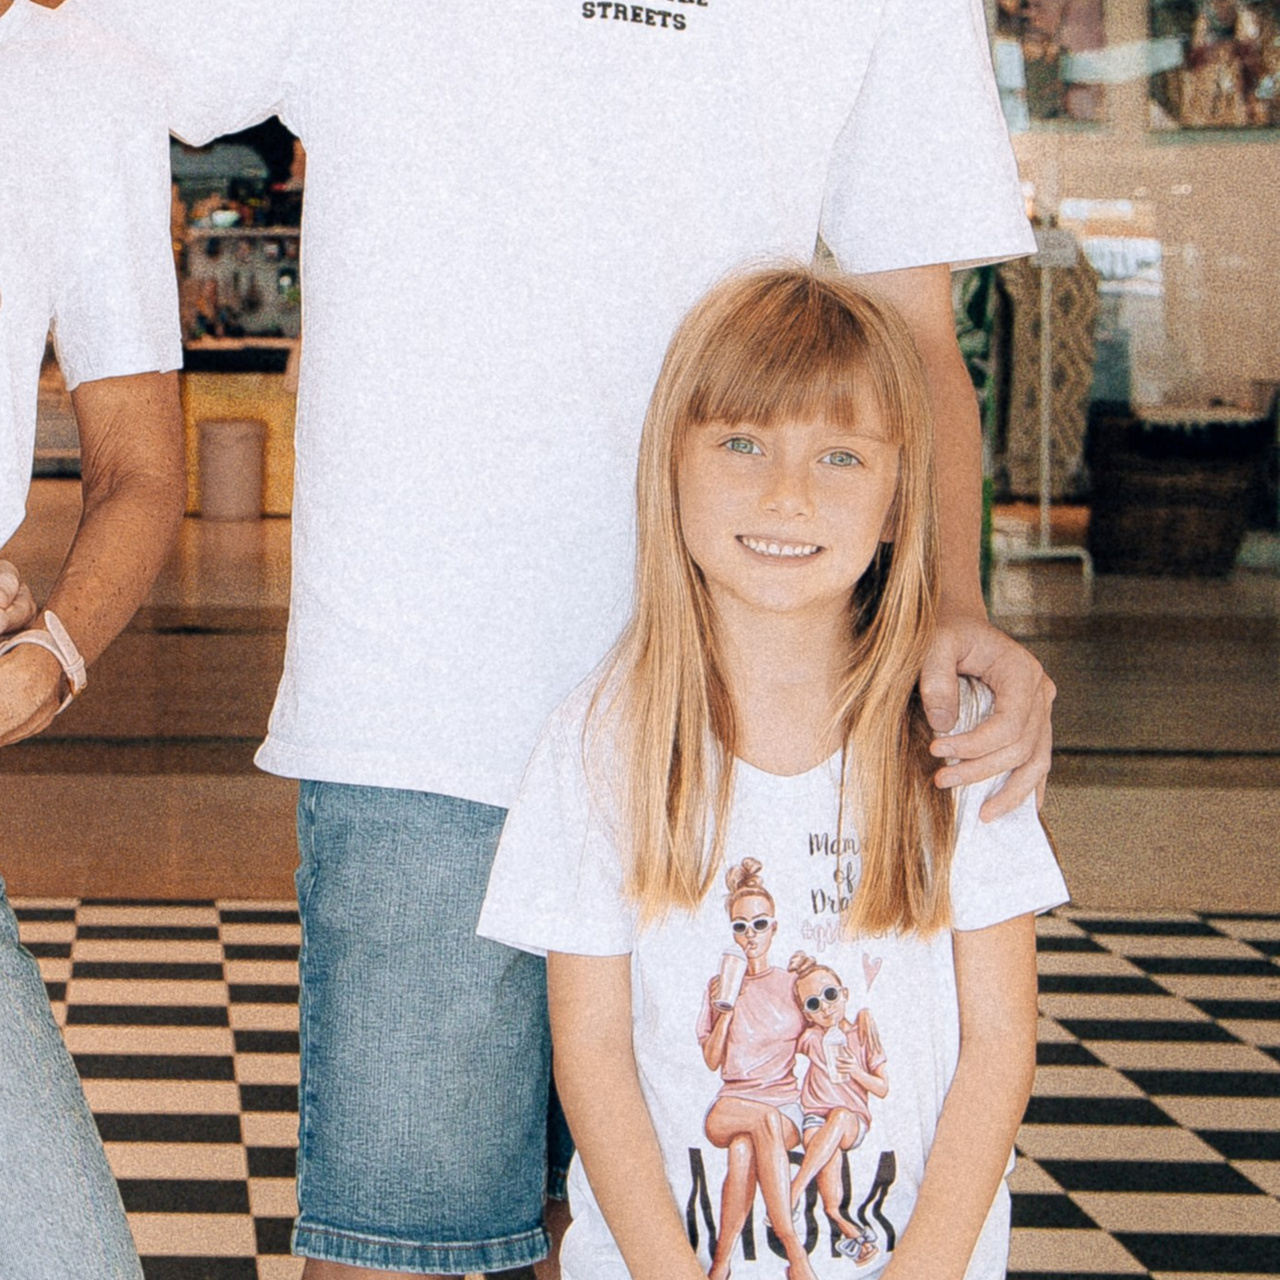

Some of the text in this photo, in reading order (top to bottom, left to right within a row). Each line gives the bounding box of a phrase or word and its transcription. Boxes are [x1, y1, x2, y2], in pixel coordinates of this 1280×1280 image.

[581, 1, 687, 31] STREETS
[833, 861, 856, 894] of
[811, 888, 851, 915] Dra
